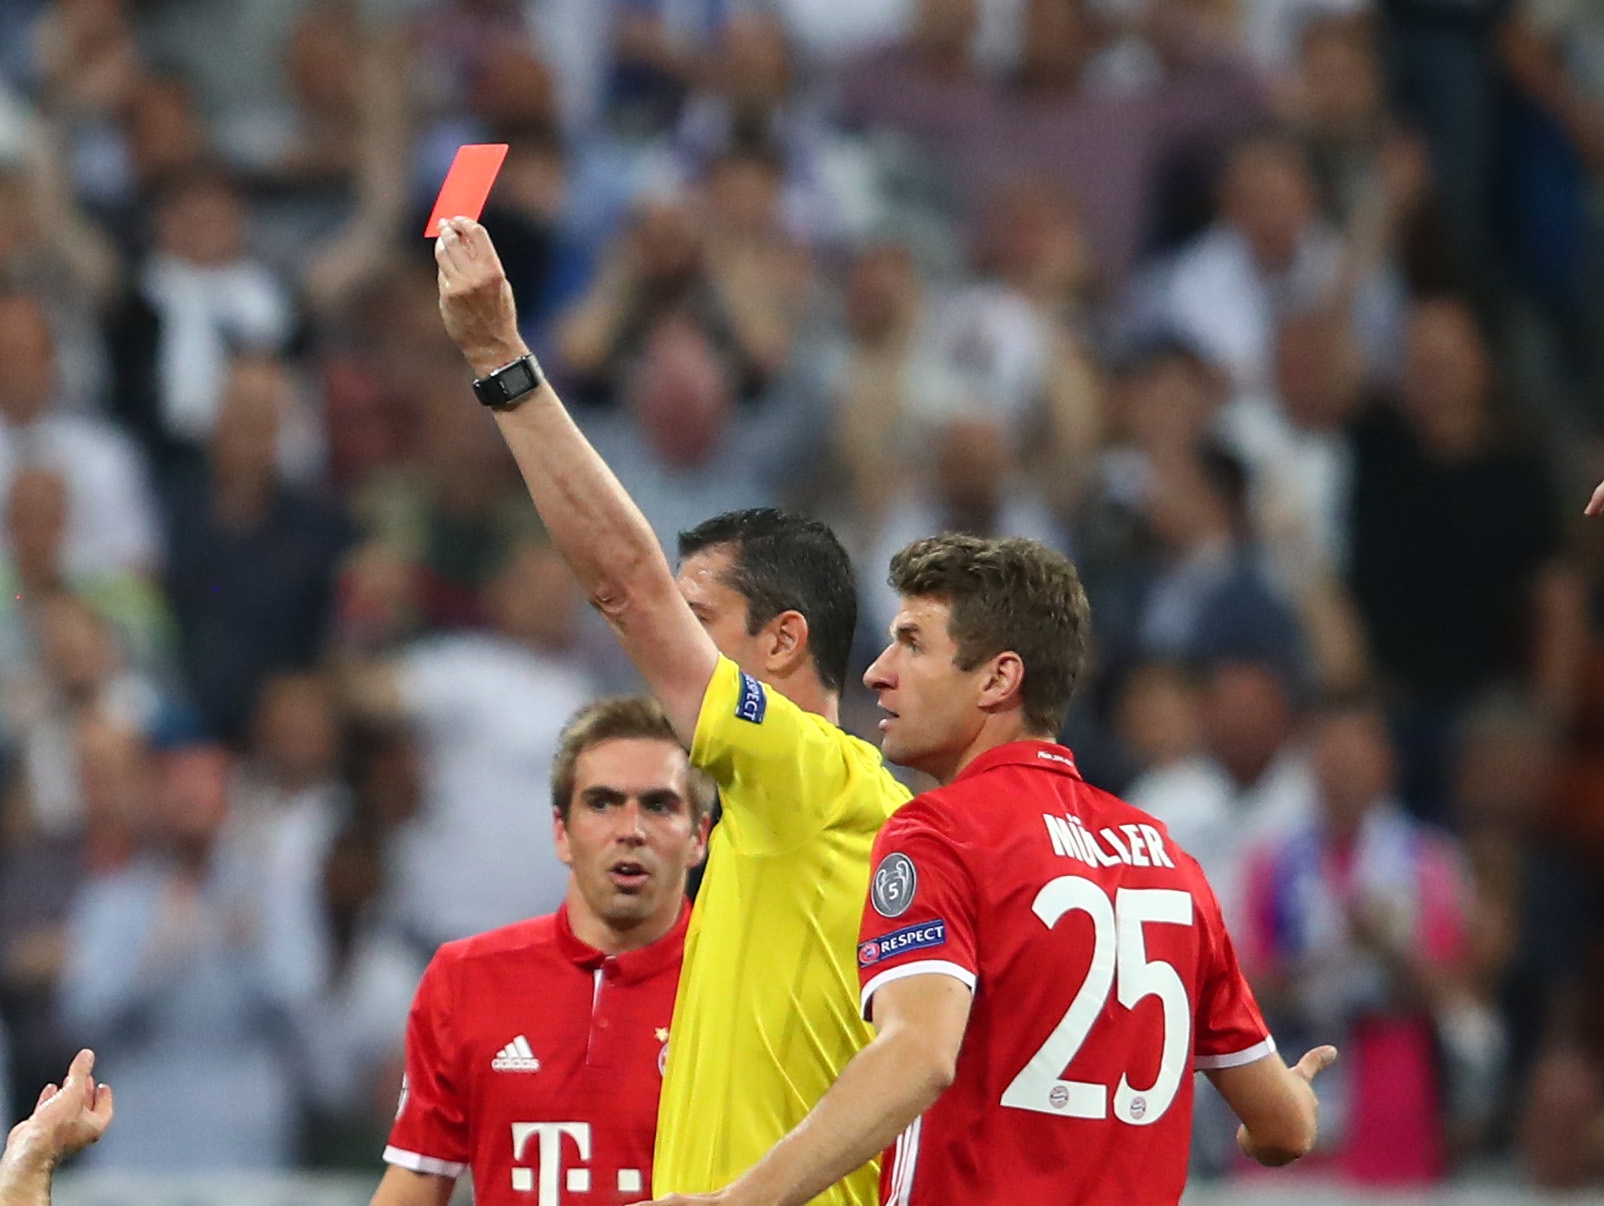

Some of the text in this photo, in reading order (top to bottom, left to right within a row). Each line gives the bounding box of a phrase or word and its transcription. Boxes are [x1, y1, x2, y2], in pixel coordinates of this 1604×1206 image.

[1043, 812, 1176, 868] MÜLLER
[888, 882, 899, 900] 5
[880, 925, 944, 953] RESPECT
[1000, 875, 1193, 1126] 25
[491, 1058, 540, 1071] adidas
